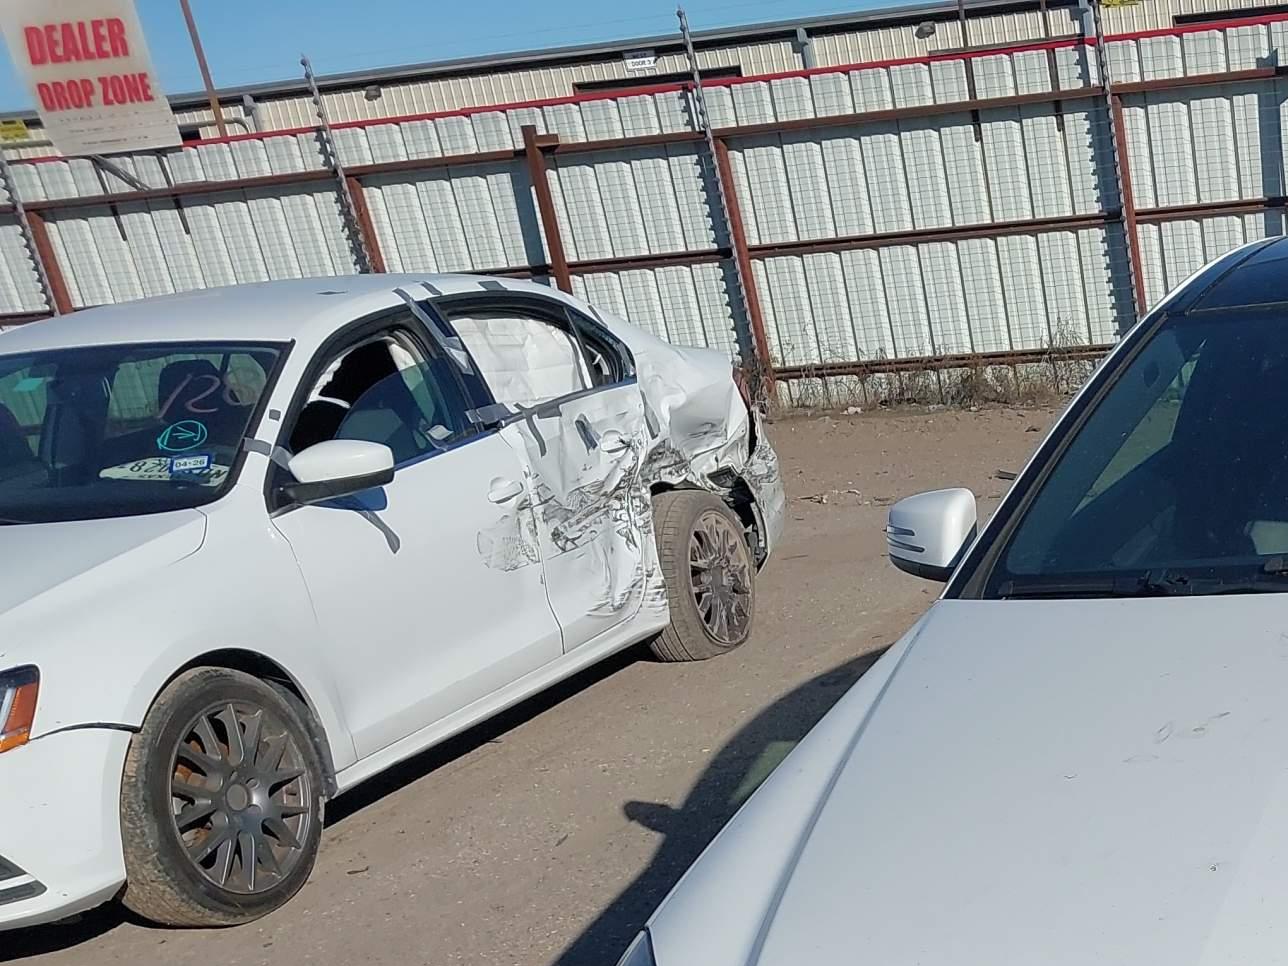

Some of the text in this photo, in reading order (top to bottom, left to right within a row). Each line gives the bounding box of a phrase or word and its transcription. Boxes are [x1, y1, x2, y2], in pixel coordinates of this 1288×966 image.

[24, 17, 130, 66] DEALER
[37, 72, 154, 112] DROP ZONE
